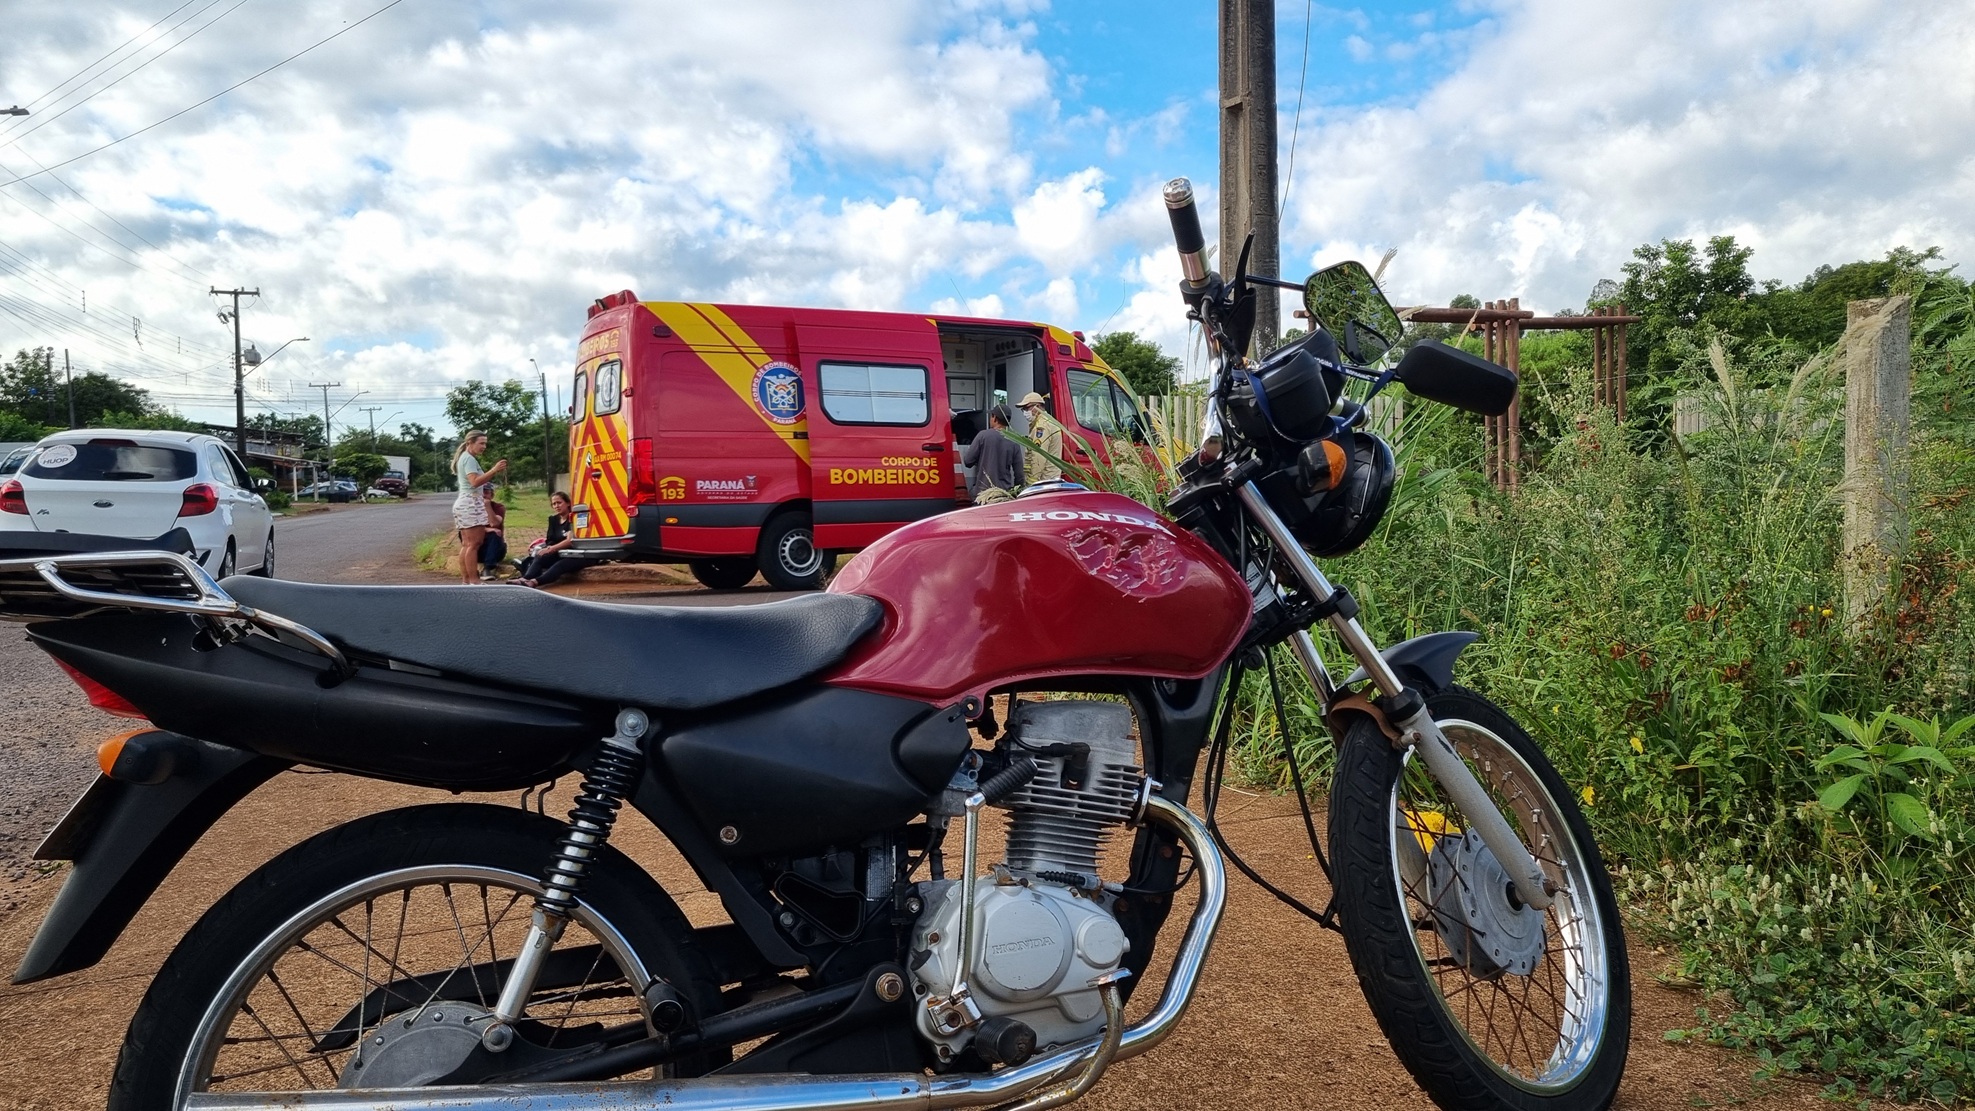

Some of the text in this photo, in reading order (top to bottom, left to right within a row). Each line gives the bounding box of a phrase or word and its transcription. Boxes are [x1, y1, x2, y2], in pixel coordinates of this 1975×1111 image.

[881, 457, 938, 467] CORPO DE
[830, 468, 940, 485] BOMBEIROS
[696, 479, 745, 490] PARANÁ
[661, 488, 686, 500] 193
[1009, 511, 1177, 538] HONDA
[991, 936, 1056, 955] HONDA
